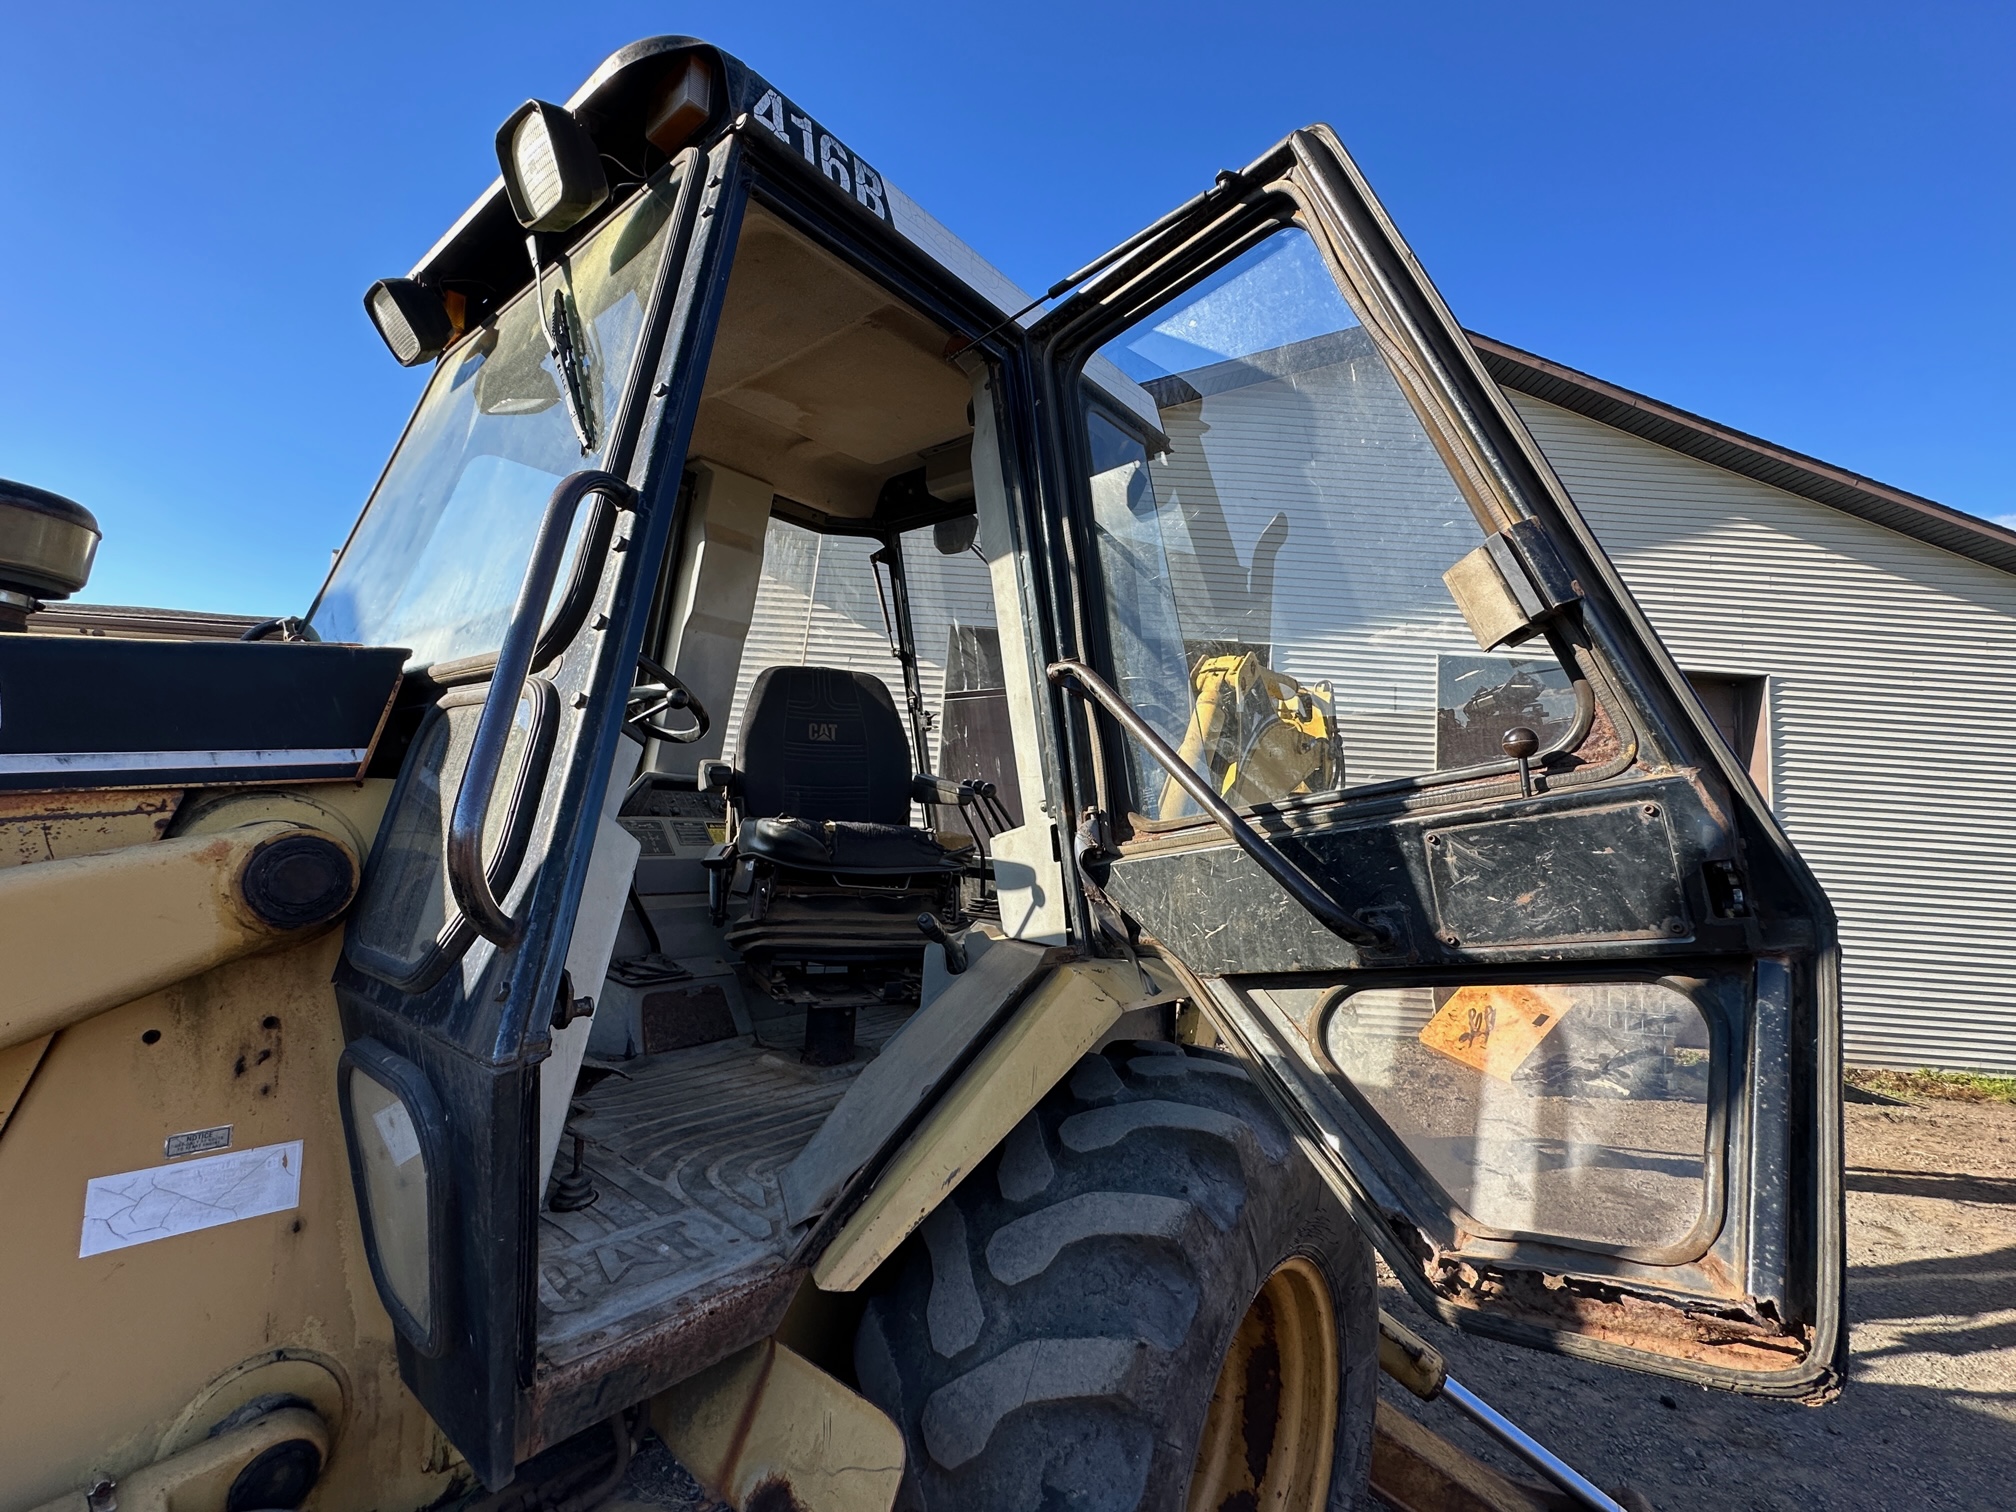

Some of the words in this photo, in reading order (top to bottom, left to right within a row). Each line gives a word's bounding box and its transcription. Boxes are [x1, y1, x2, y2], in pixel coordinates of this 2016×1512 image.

[754, 89, 885, 220] 416B
[808, 723, 838, 741] CAT
[187, 1132, 212, 1142] NOTICE
